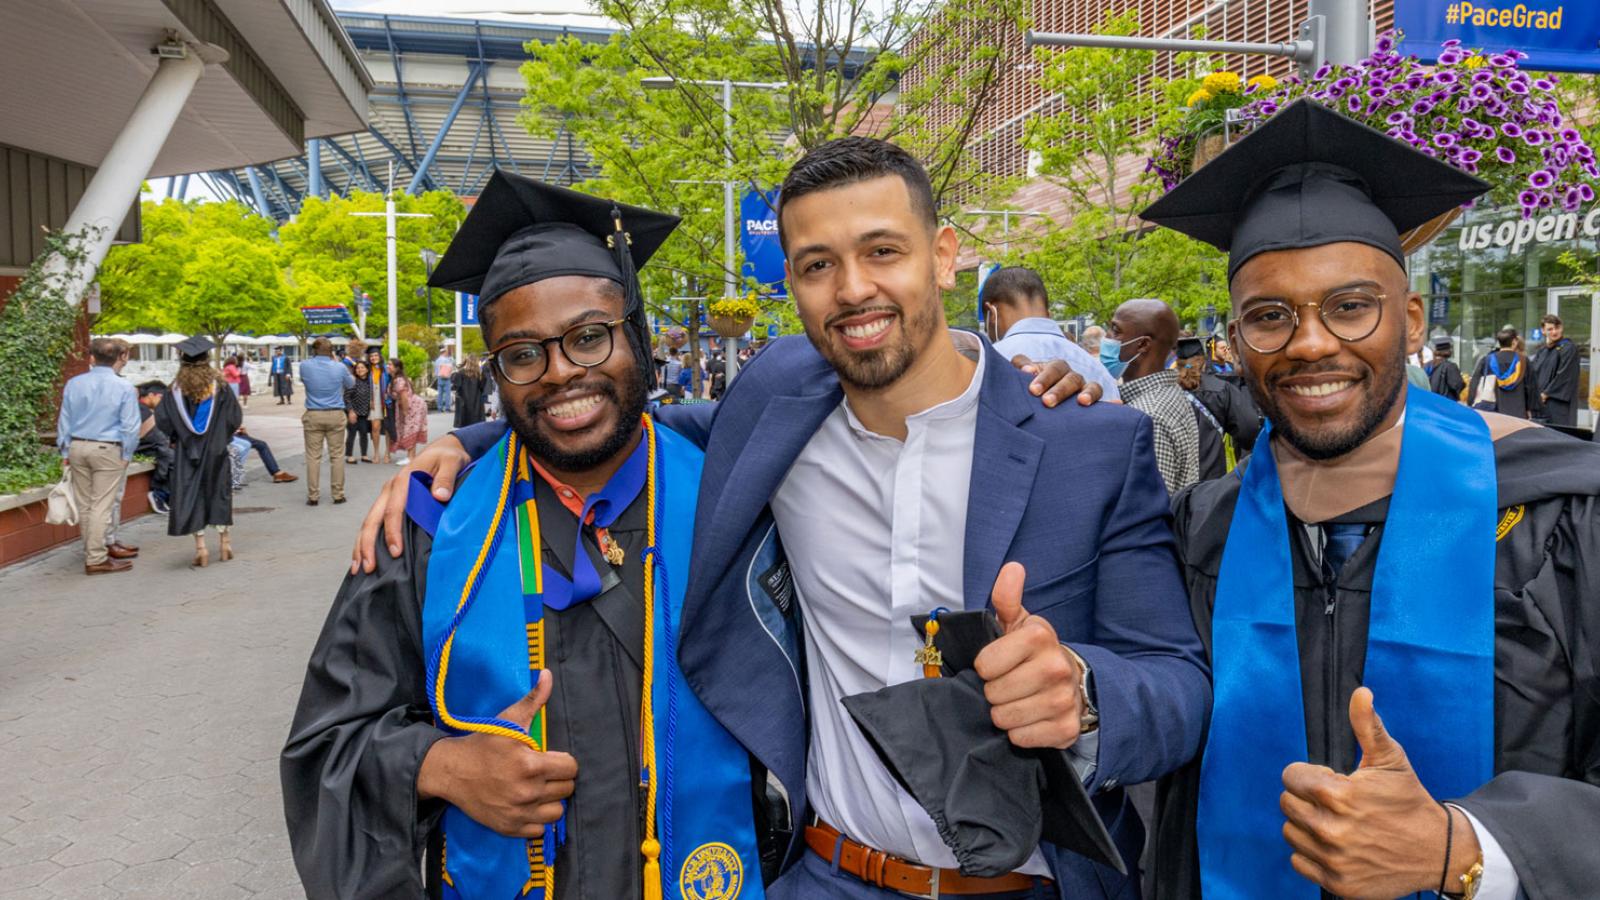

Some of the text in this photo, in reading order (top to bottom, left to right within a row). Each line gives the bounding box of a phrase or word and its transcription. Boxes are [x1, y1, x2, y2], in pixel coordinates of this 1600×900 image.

[1446, 1, 1563, 29] #PaceGrad
[746, 219, 779, 230] PACE
[914, 647, 943, 665] 2021
